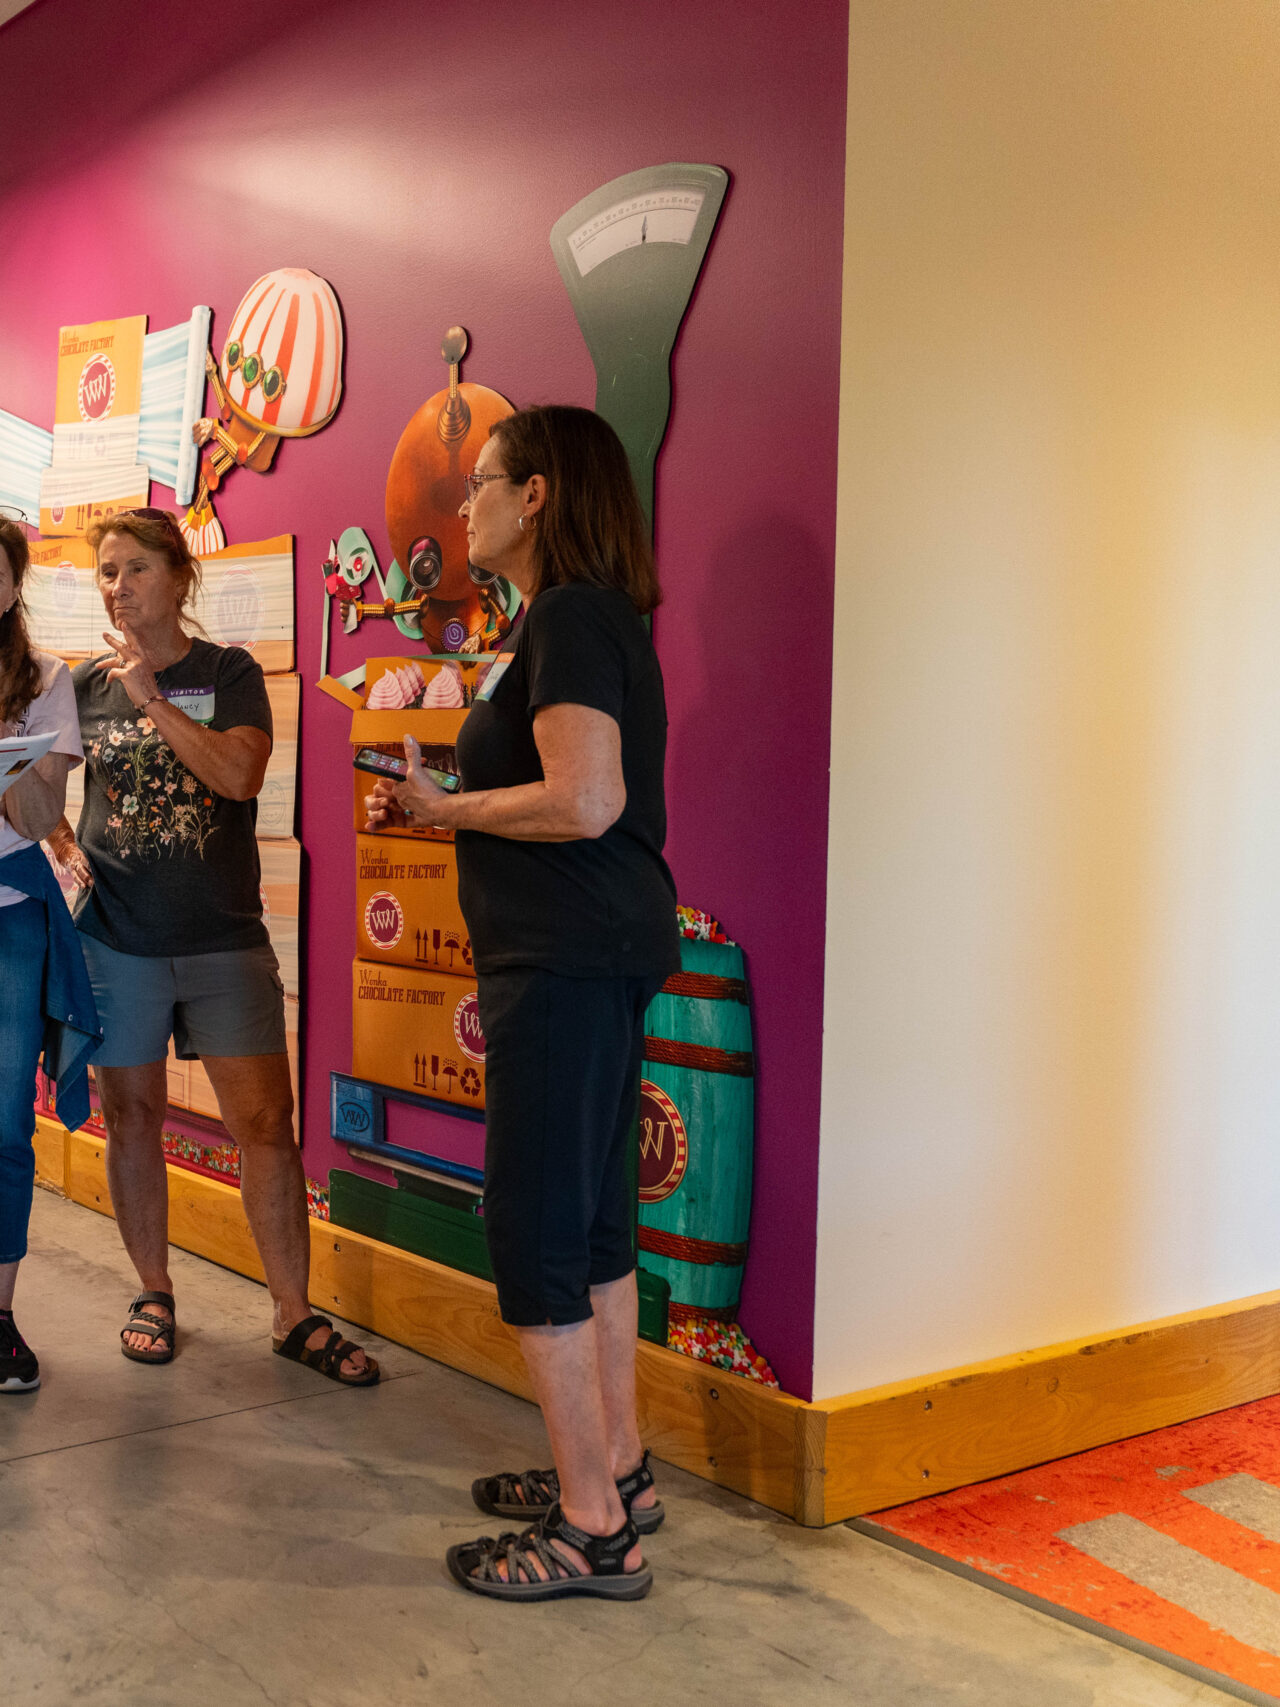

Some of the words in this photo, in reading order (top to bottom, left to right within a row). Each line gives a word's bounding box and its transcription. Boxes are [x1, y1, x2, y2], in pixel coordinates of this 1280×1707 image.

[90, 335, 114, 352] FACTORY
[83, 372, 109, 407] WW
[360, 848, 388, 865] Wonka
[360, 865, 405, 880] CHOCOLATE
[407, 864, 447, 879] FACTORY
[370, 908, 396, 931] WW
[360, 969, 387, 986] Wonka
[358, 985, 404, 1003] CHOCOLATE
[406, 989, 446, 1006] FACTORY
[341, 1107, 366, 1127] WW
